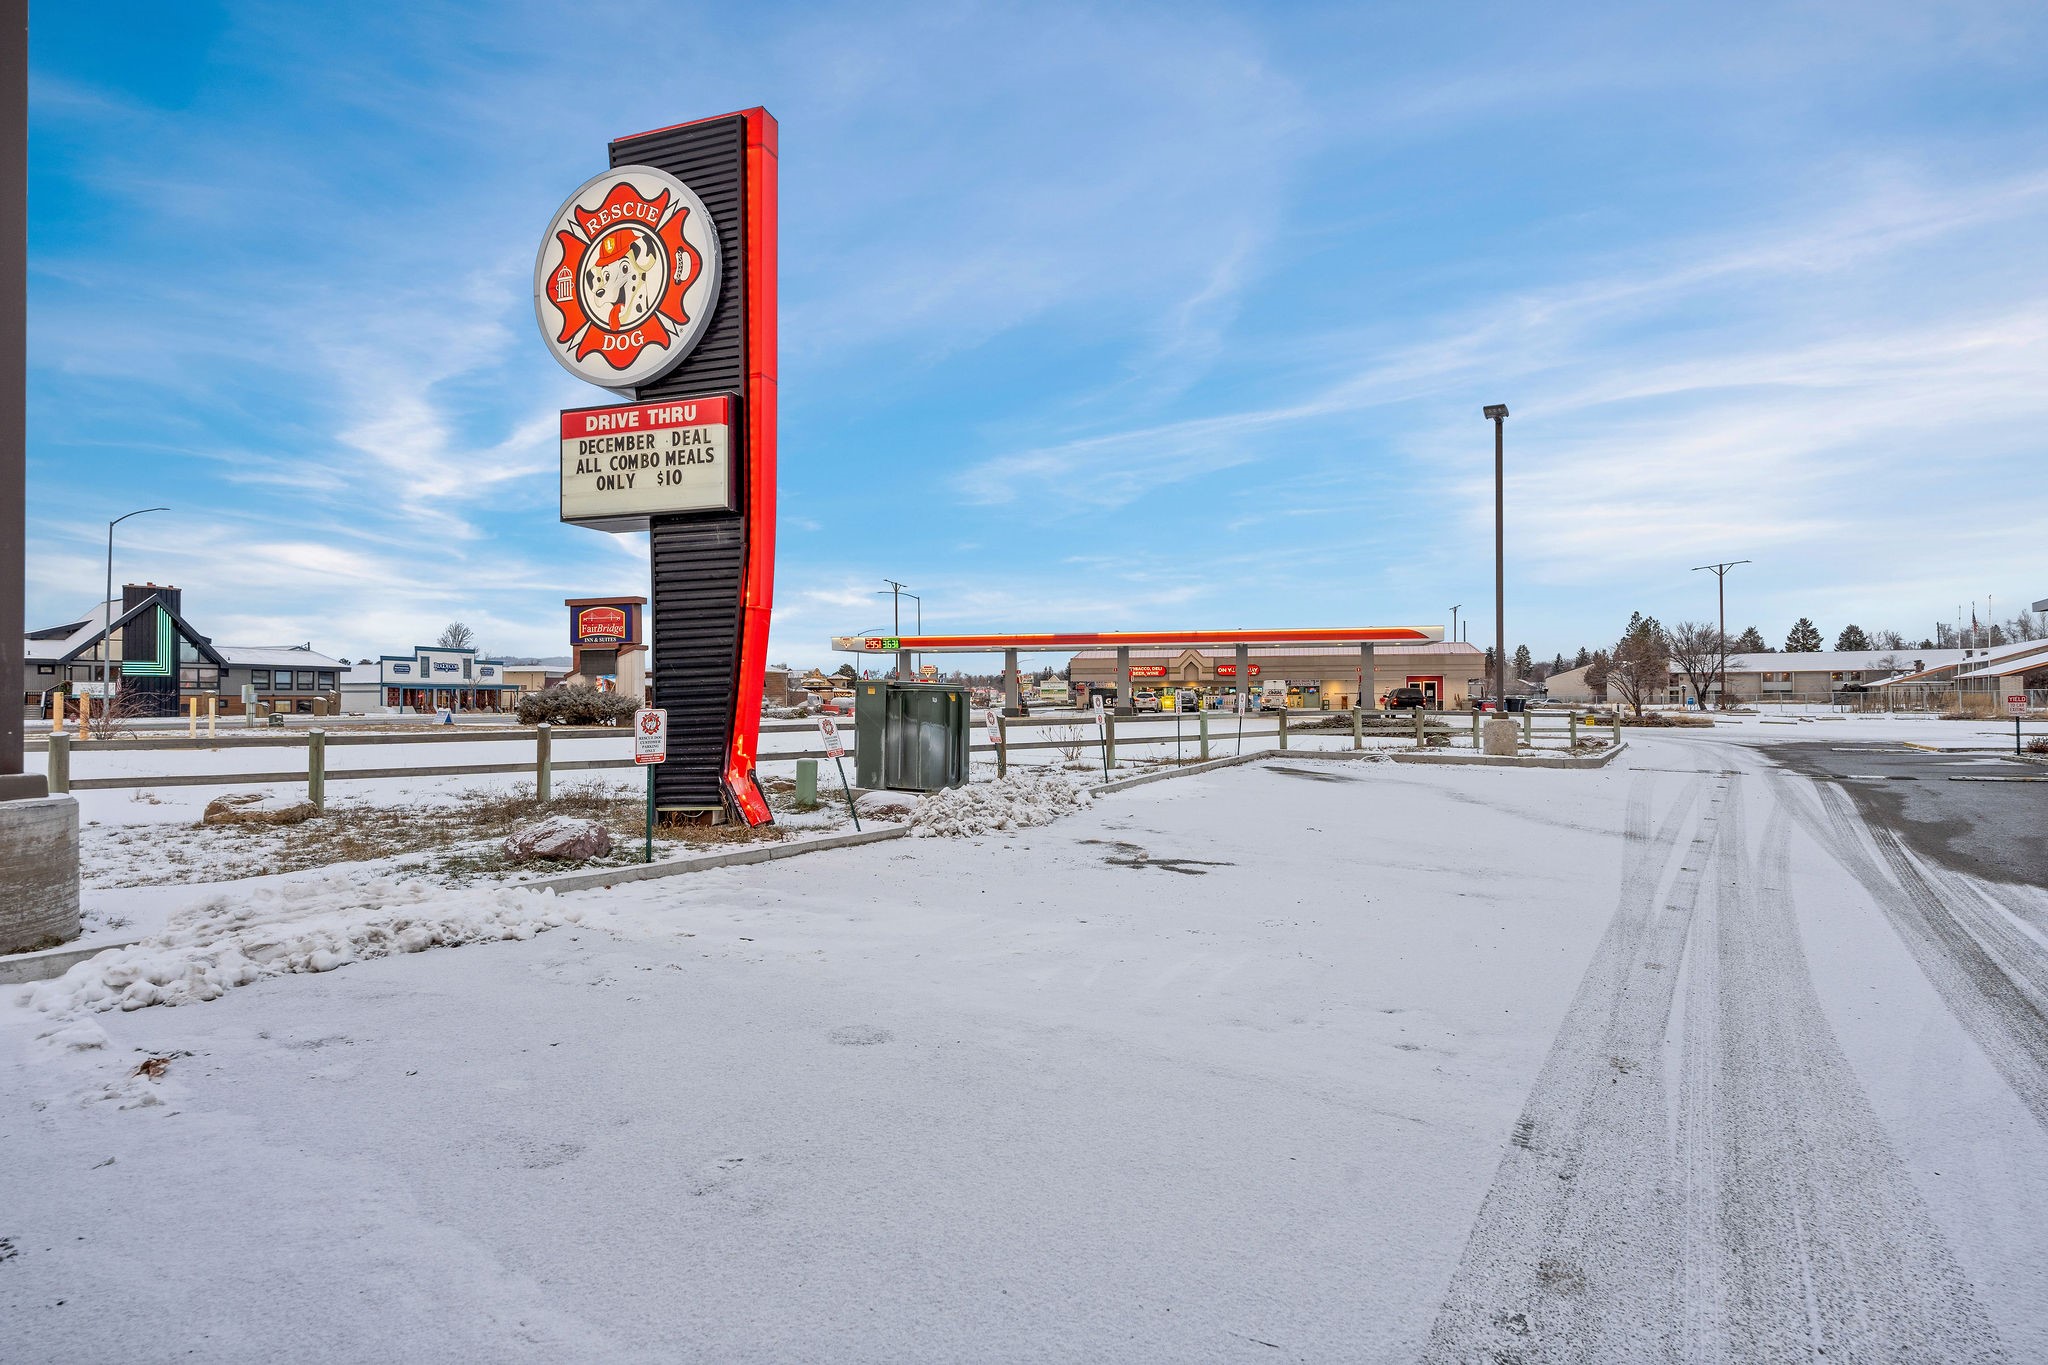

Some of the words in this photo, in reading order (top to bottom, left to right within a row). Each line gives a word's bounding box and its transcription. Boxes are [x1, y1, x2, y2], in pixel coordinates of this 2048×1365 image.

[586, 202, 659, 235] RESCUE
[602, 330, 645, 351] DOG
[586, 411, 639, 432] DRIVE
[647, 405, 697, 425] THRU
[579, 434, 655, 456] DECEMBER
[672, 428, 712, 447] DEAL
[576, 459, 602, 475] ALL
[610, 447, 660, 472] COMBO
[666, 442, 715, 467] MEALS
[597, 473, 636, 491] ONLY
[657, 469, 683, 486] $10
[582, 624, 624, 635] FairBridge
